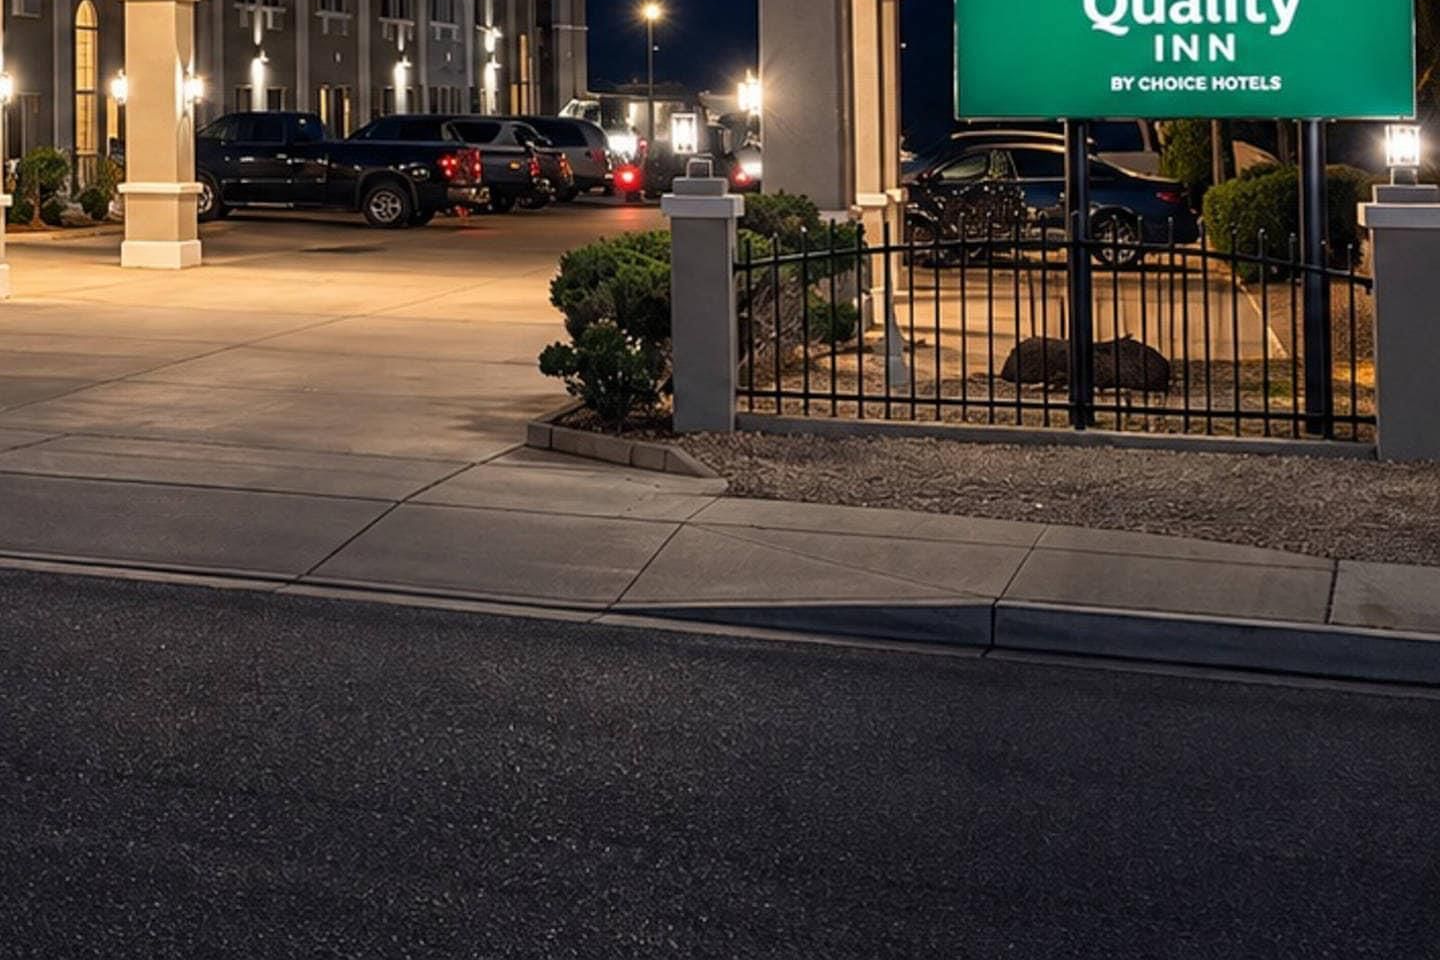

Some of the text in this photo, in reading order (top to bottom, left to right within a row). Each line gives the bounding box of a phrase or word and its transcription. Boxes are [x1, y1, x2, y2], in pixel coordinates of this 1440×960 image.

[1155, 33, 1235, 62] INN
[1111, 75, 1282, 91] BY CHOICE HOTELS
